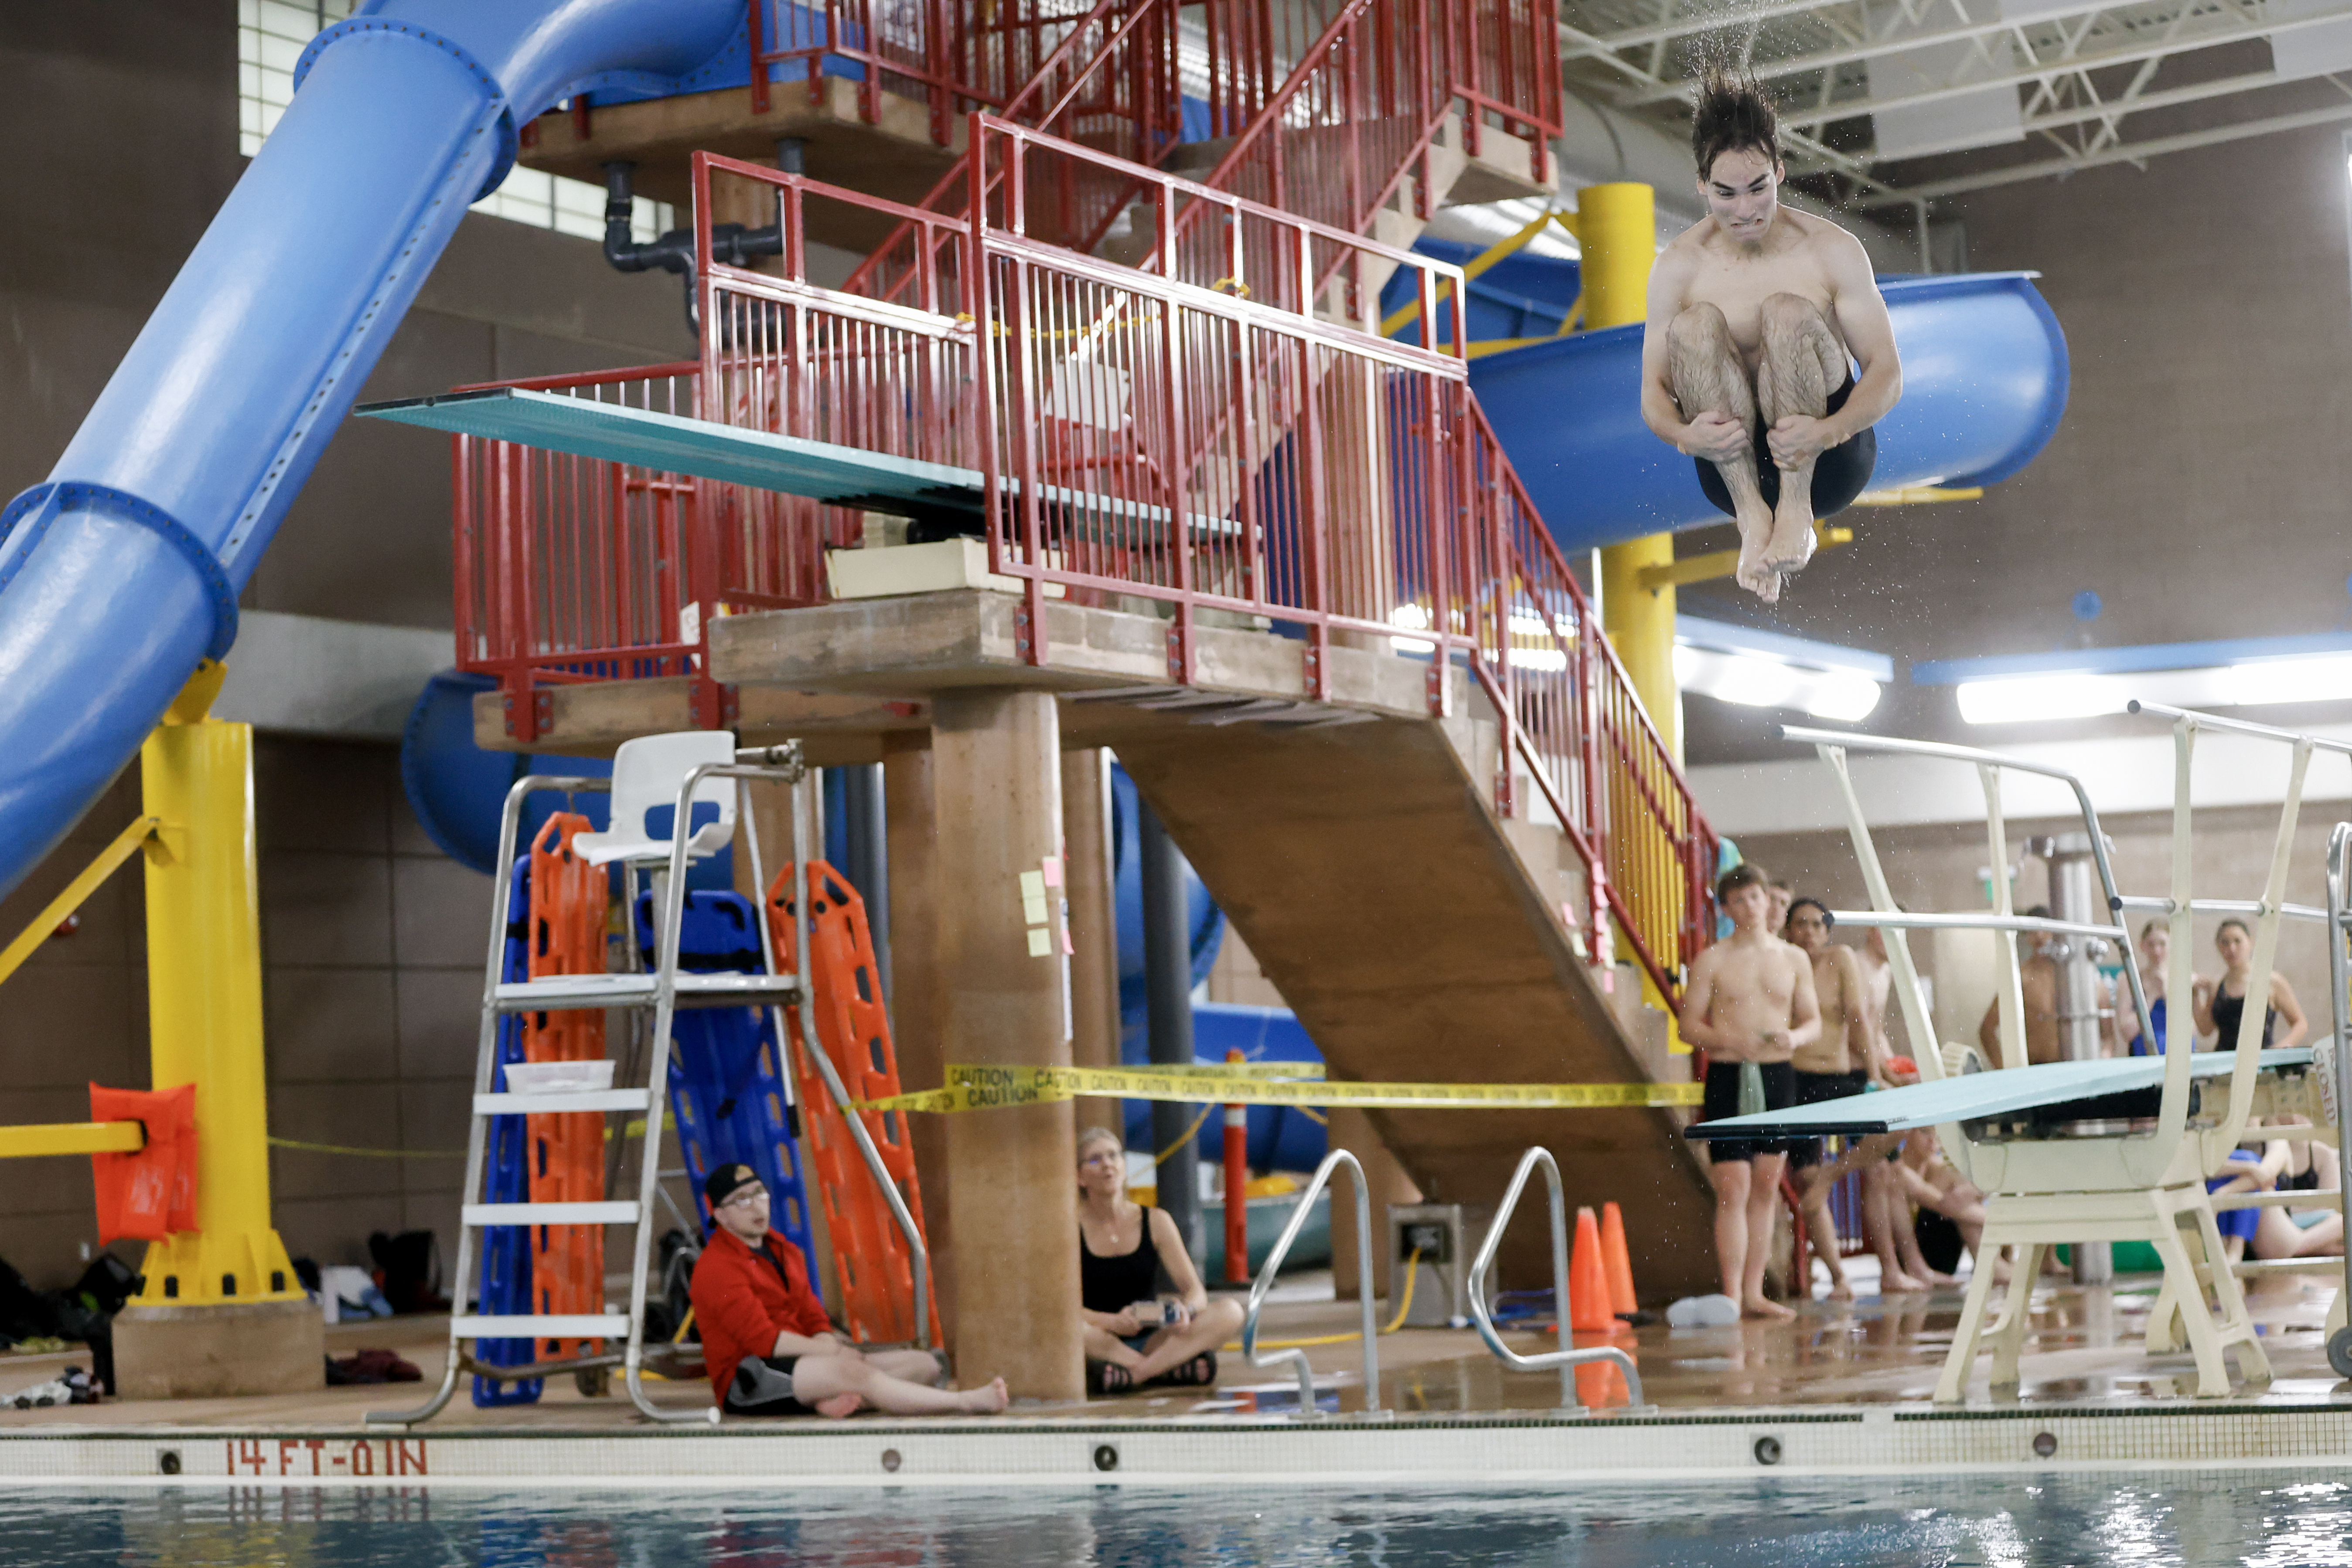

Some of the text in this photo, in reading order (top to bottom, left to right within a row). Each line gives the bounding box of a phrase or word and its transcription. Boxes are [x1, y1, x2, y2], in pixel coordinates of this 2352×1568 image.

[951, 1068, 1013, 1087] CAUTION
[2315, 1048, 2336, 1121] CLOSED
[967, 1085, 1037, 1107] CAUTION
[227, 1438, 266, 1475] 14
